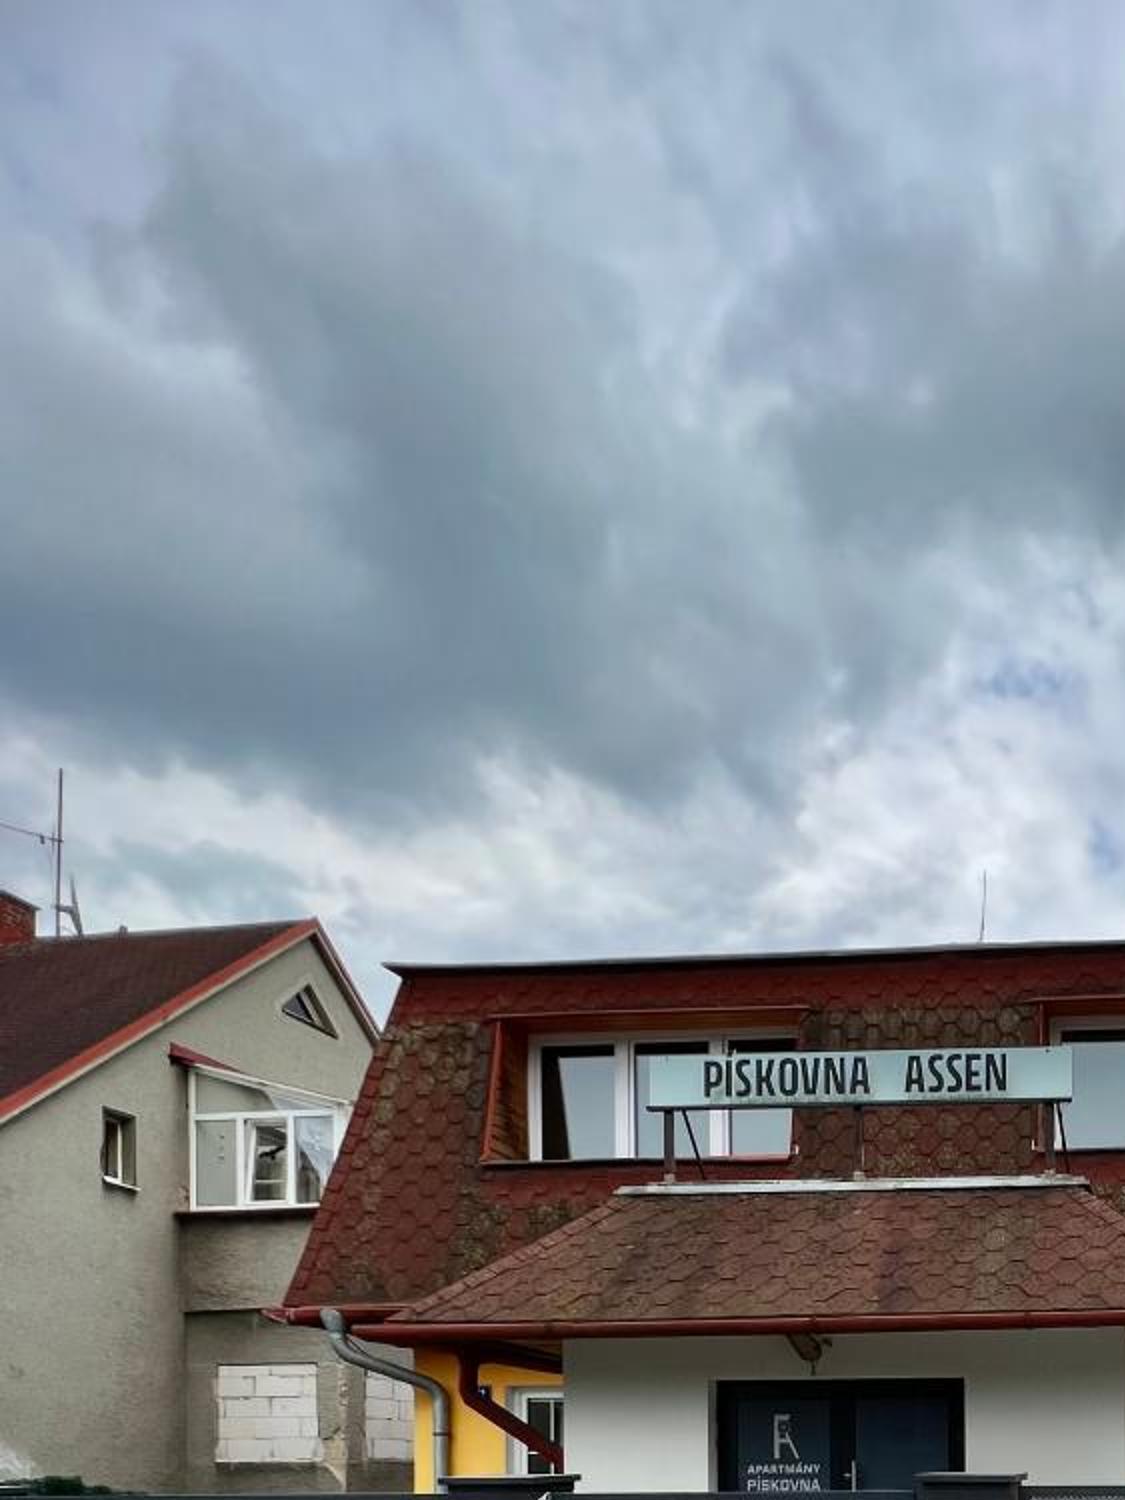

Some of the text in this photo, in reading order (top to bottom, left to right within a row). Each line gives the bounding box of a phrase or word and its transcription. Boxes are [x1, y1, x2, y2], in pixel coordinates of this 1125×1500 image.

[904, 1053, 1006, 1093] ASSEN
[747, 1462, 820, 1474] APARTMÁNY
[747, 1475, 821, 1492] PÍSKOVNA
